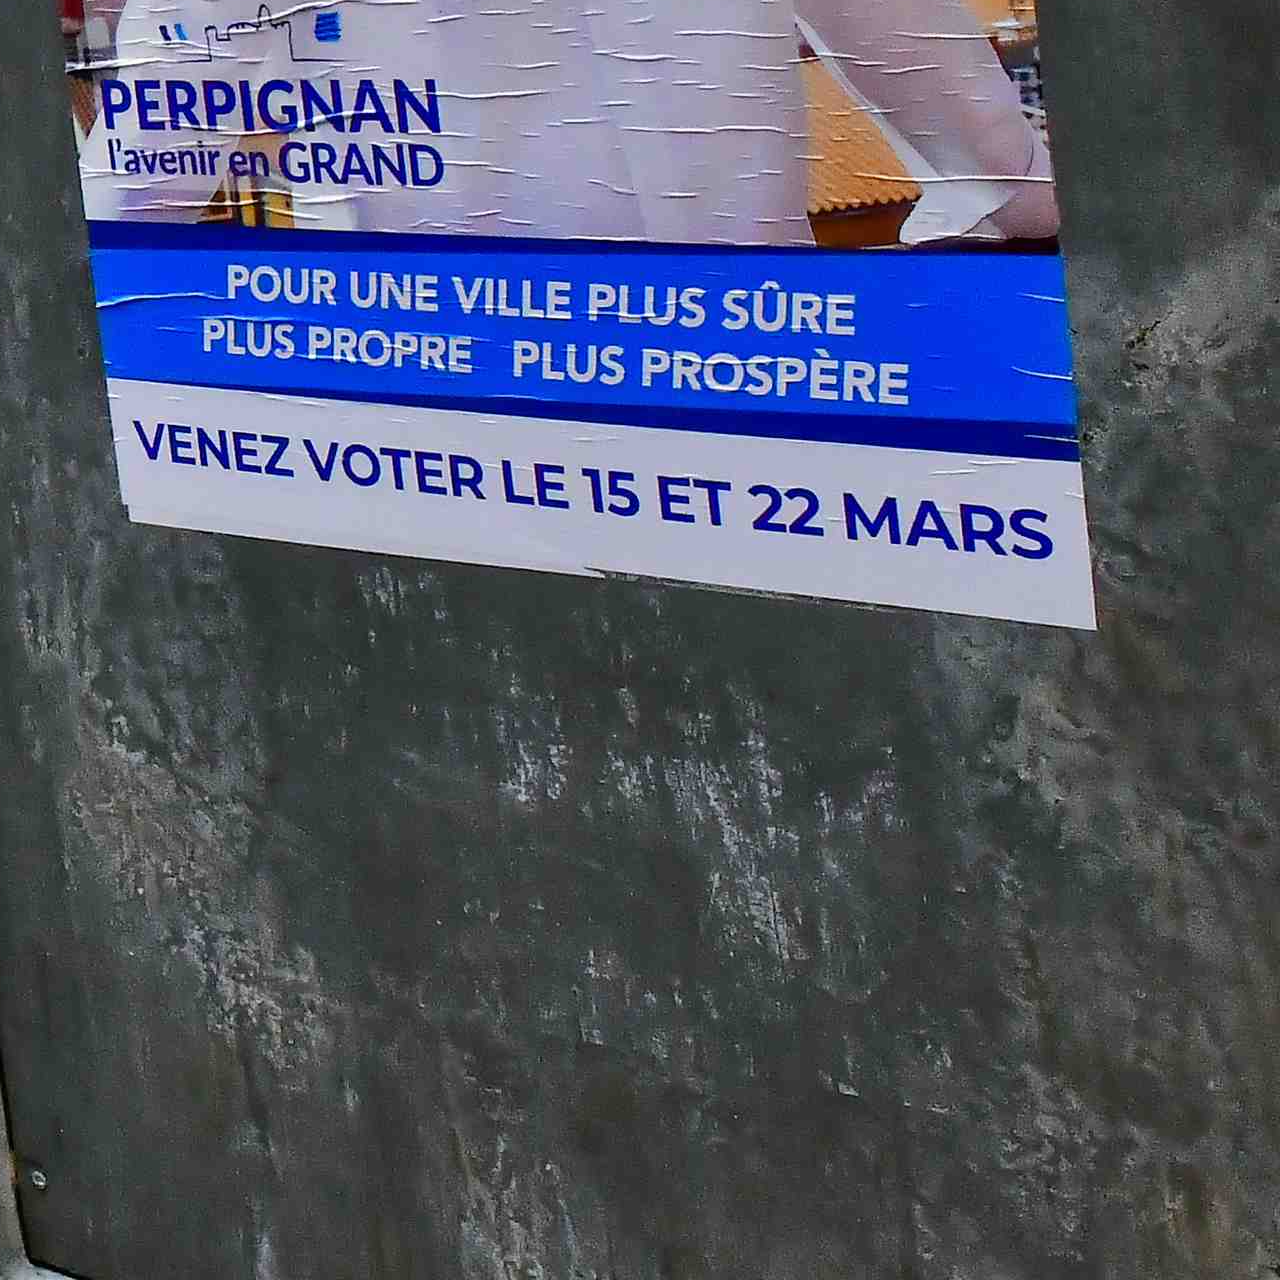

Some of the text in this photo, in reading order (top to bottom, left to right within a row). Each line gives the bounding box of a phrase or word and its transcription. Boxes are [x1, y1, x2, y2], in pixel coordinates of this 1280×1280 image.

[100, 78, 441, 134] PERPIGNAN
[107, 139, 445, 187] l'avenir en GRAND
[225, 264, 857, 337] POUR UNE VILLE PLUS SÛRE
[201, 318, 912, 407] PLUS PROPRE PLUS PROSPÈRE
[131, 419, 1054, 562] VENEZ VOTER LE 15 ET 22 MARS
